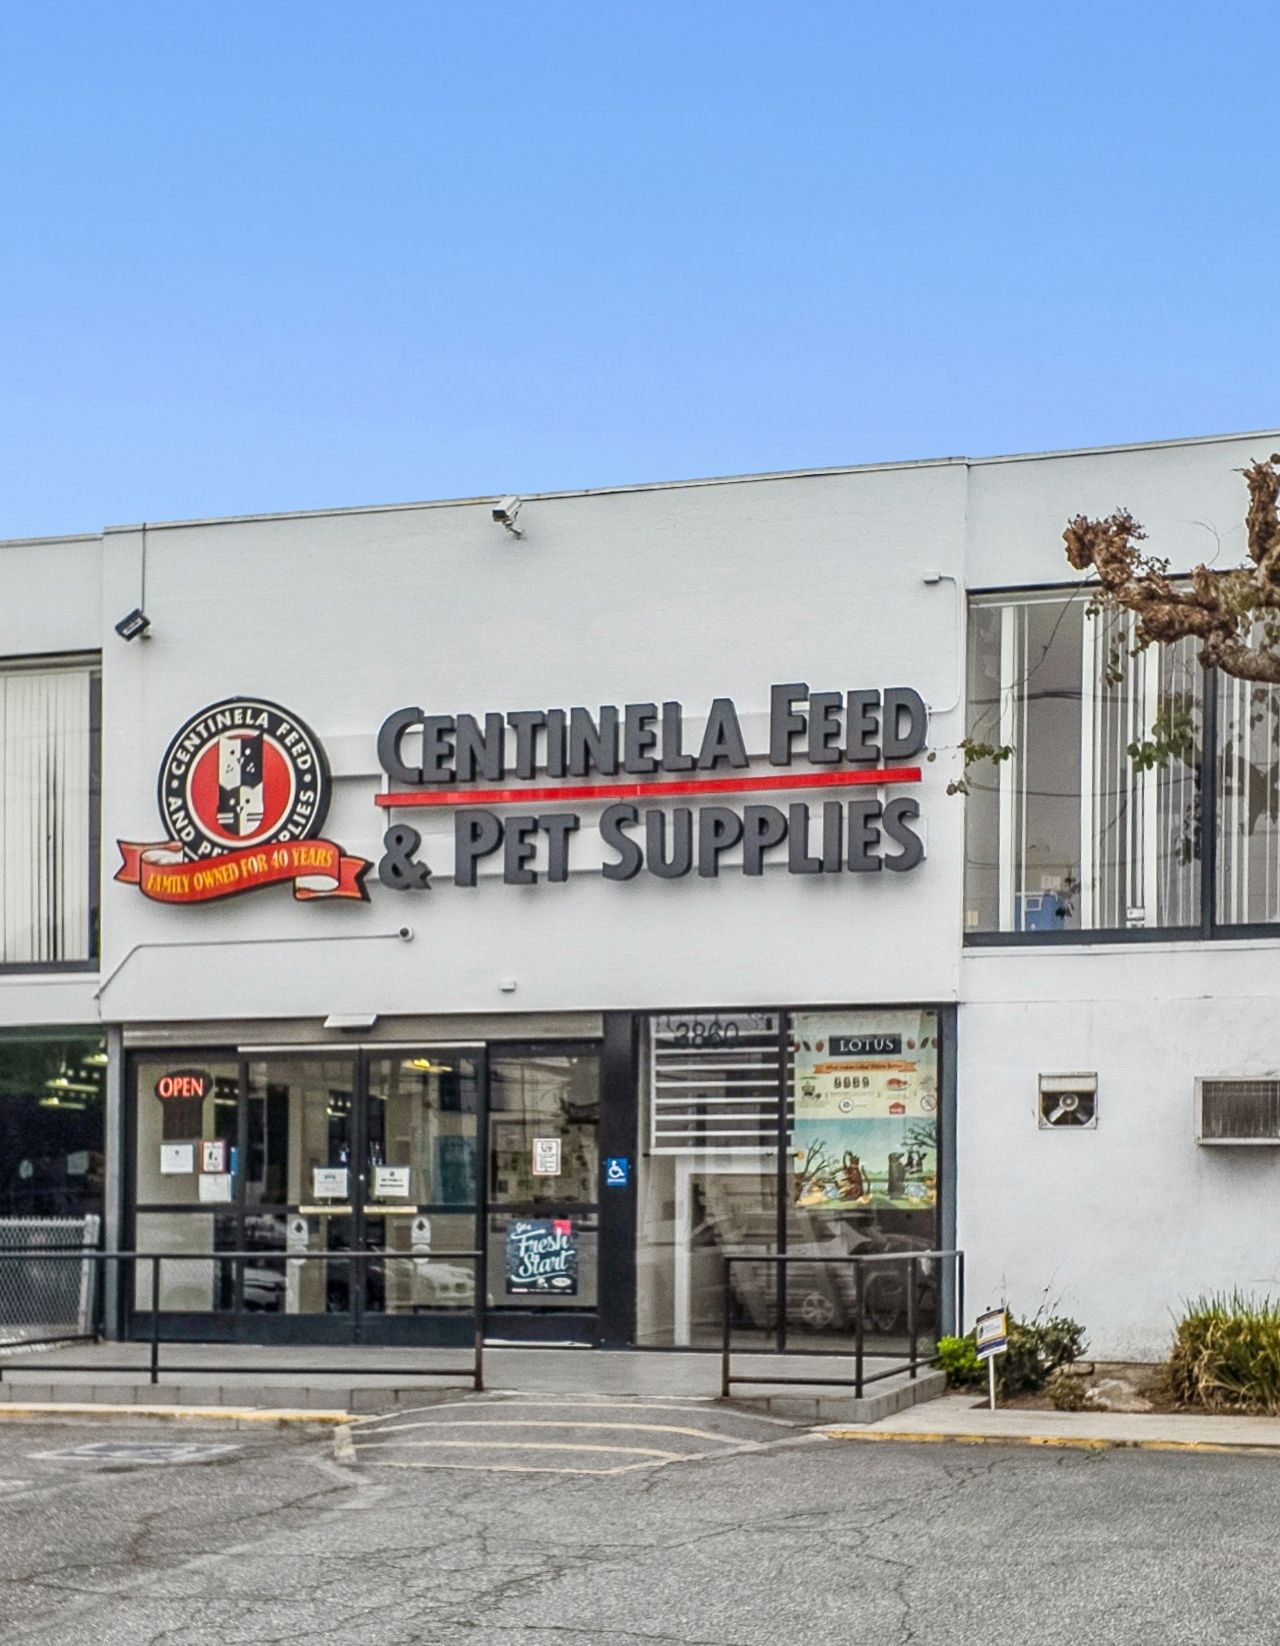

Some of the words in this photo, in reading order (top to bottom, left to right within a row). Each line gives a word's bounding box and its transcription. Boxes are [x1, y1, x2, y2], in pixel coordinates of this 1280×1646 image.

[172, 708, 269, 775] CENTINELA
[276, 722, 312, 771] FEED
[377, 698, 750, 784] CENTINELA
[770, 682, 927, 766] FEED
[168, 796, 195, 842] AND
[272, 790, 315, 843] PLIES
[378, 824, 432, 890] &
[454, 808, 580, 887] PET
[599, 797, 926, 881] SUPPLIES
[147, 872, 190, 894] FAMILY
[193, 862, 240, 890] OWNED
[240, 853, 268, 876] FOR
[271, 849, 289, 867] 40
[292, 846, 333, 869] YEARS
[840, 1039, 894, 1052] LOTUS
[159, 1077, 204, 1097] OPEN
[511, 1227, 570, 1257] Fresh
[519, 1250, 575, 1277] Start
